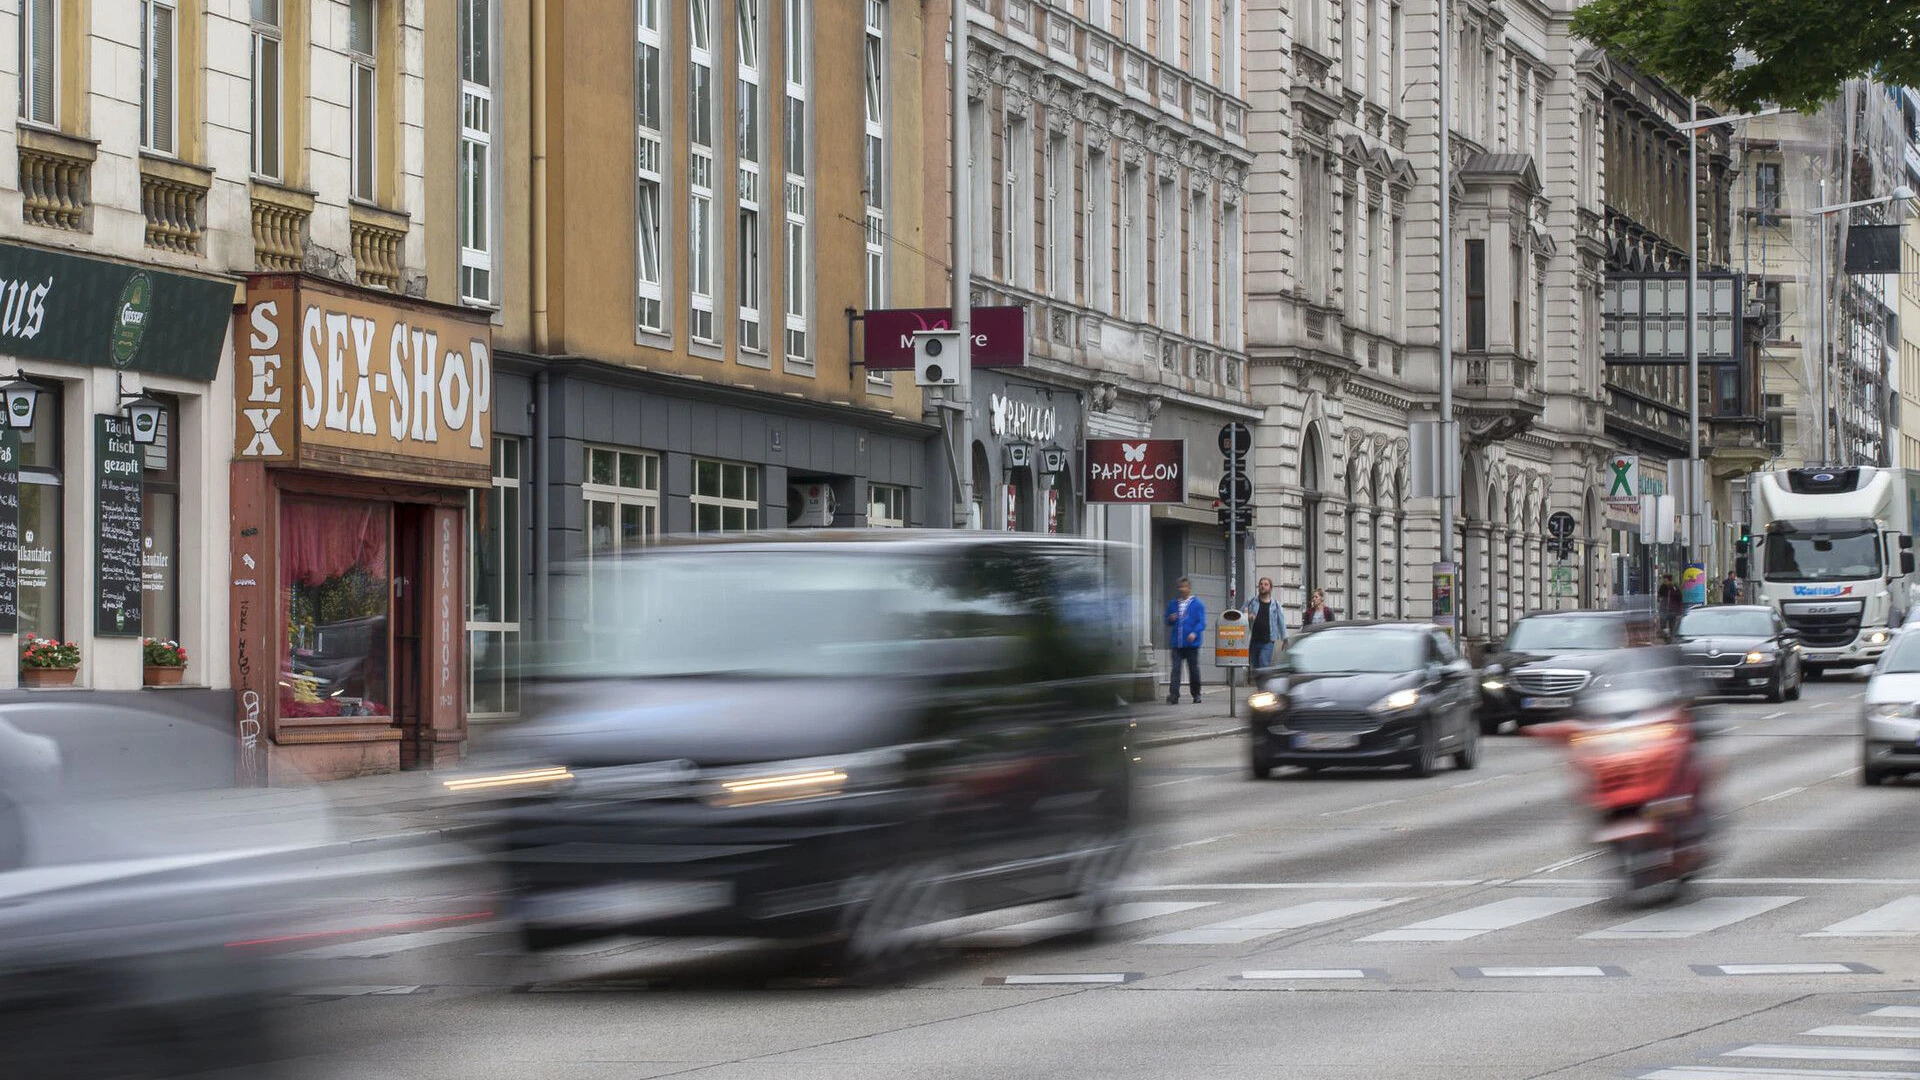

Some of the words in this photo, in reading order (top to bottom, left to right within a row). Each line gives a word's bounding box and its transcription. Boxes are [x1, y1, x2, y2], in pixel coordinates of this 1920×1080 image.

[0, 276, 53, 340] us
[242, 300, 284, 457] SEX
[301, 304, 491, 449] SEX-SHOP
[1008, 399, 1056, 441] PAPILLON
[108, 438, 135, 454] frisch
[104, 459, 139, 475] gezapft
[1091, 463, 1178, 480] PAPILLON
[1113, 483, 1155, 499] Café
